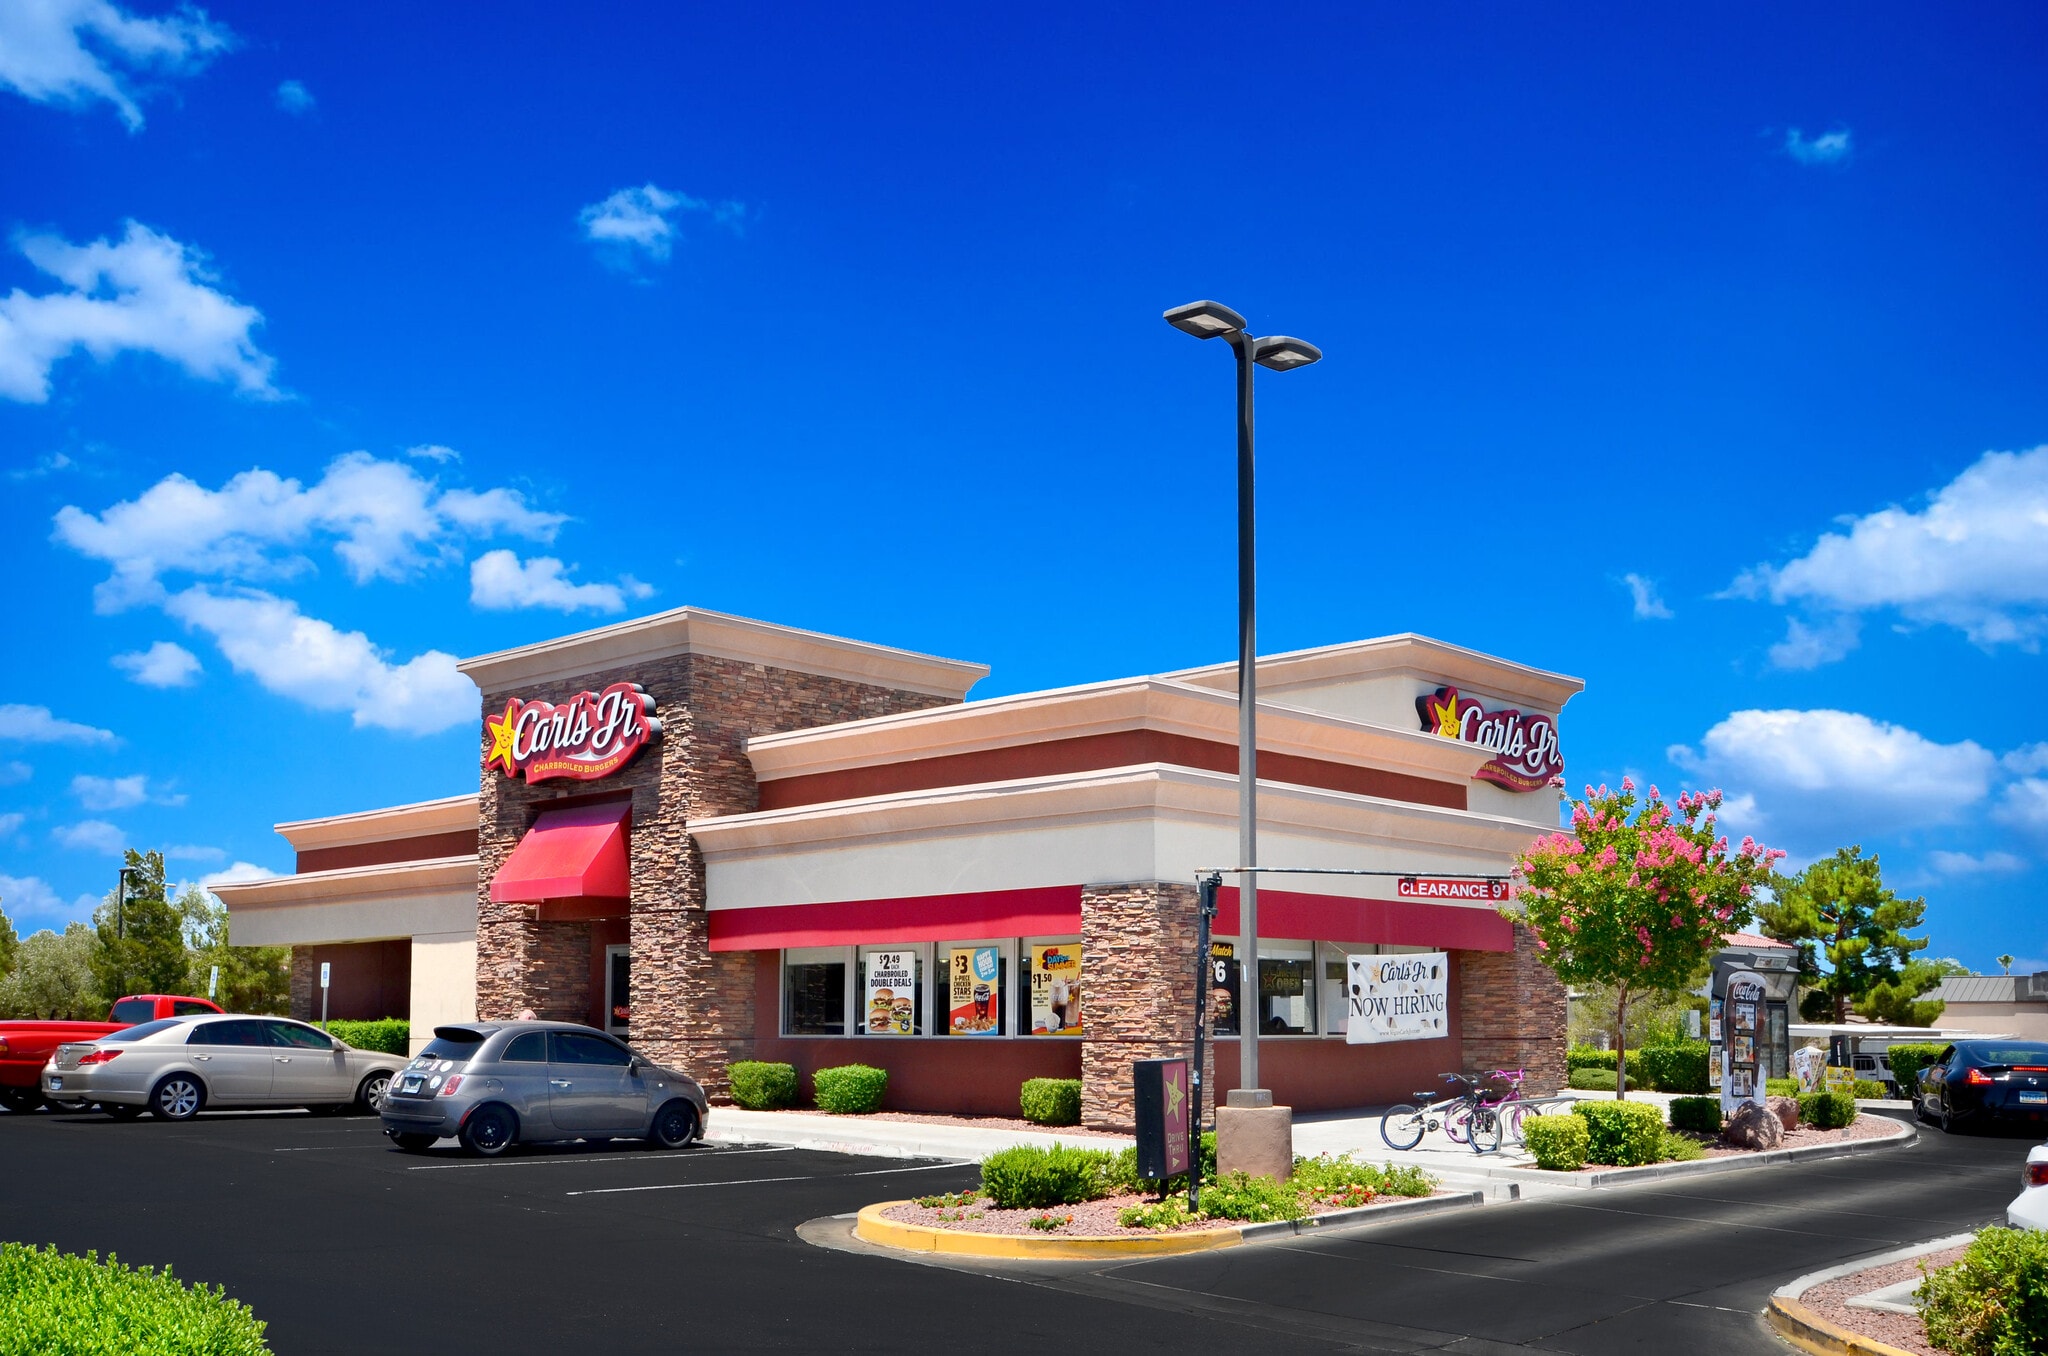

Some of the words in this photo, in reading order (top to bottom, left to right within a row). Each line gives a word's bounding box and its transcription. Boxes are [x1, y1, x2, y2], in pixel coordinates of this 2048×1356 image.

[512, 697, 592, 761] Carl's
[591, 691, 643, 749] Jr.
[1525, 721, 1563, 768] Jr.
[534, 761, 583, 773] CHARBROILED
[584, 757, 619, 773] BURGERS
[1400, 882, 1489, 897] CLEARANCE
[879, 954, 900, 970] $2.49
[955, 955, 968, 974] $3
[1048, 960, 1077, 970] SUMMER
[874, 970, 908, 978] CHARBROILED
[1212, 960, 1226, 982] $6
[1380, 962, 1411, 983] Carl's
[870, 978, 893, 988] DOUBLE
[894, 977, 912, 988] DEALS
[1033, 973, 1052, 989] $1.50
[1350, 998, 1389, 1017] NOW
[1394, 993, 1444, 1015] HIRING
[1168, 1131, 1184, 1143] DRIVE
[1168, 1143, 1184, 1155] THRU
